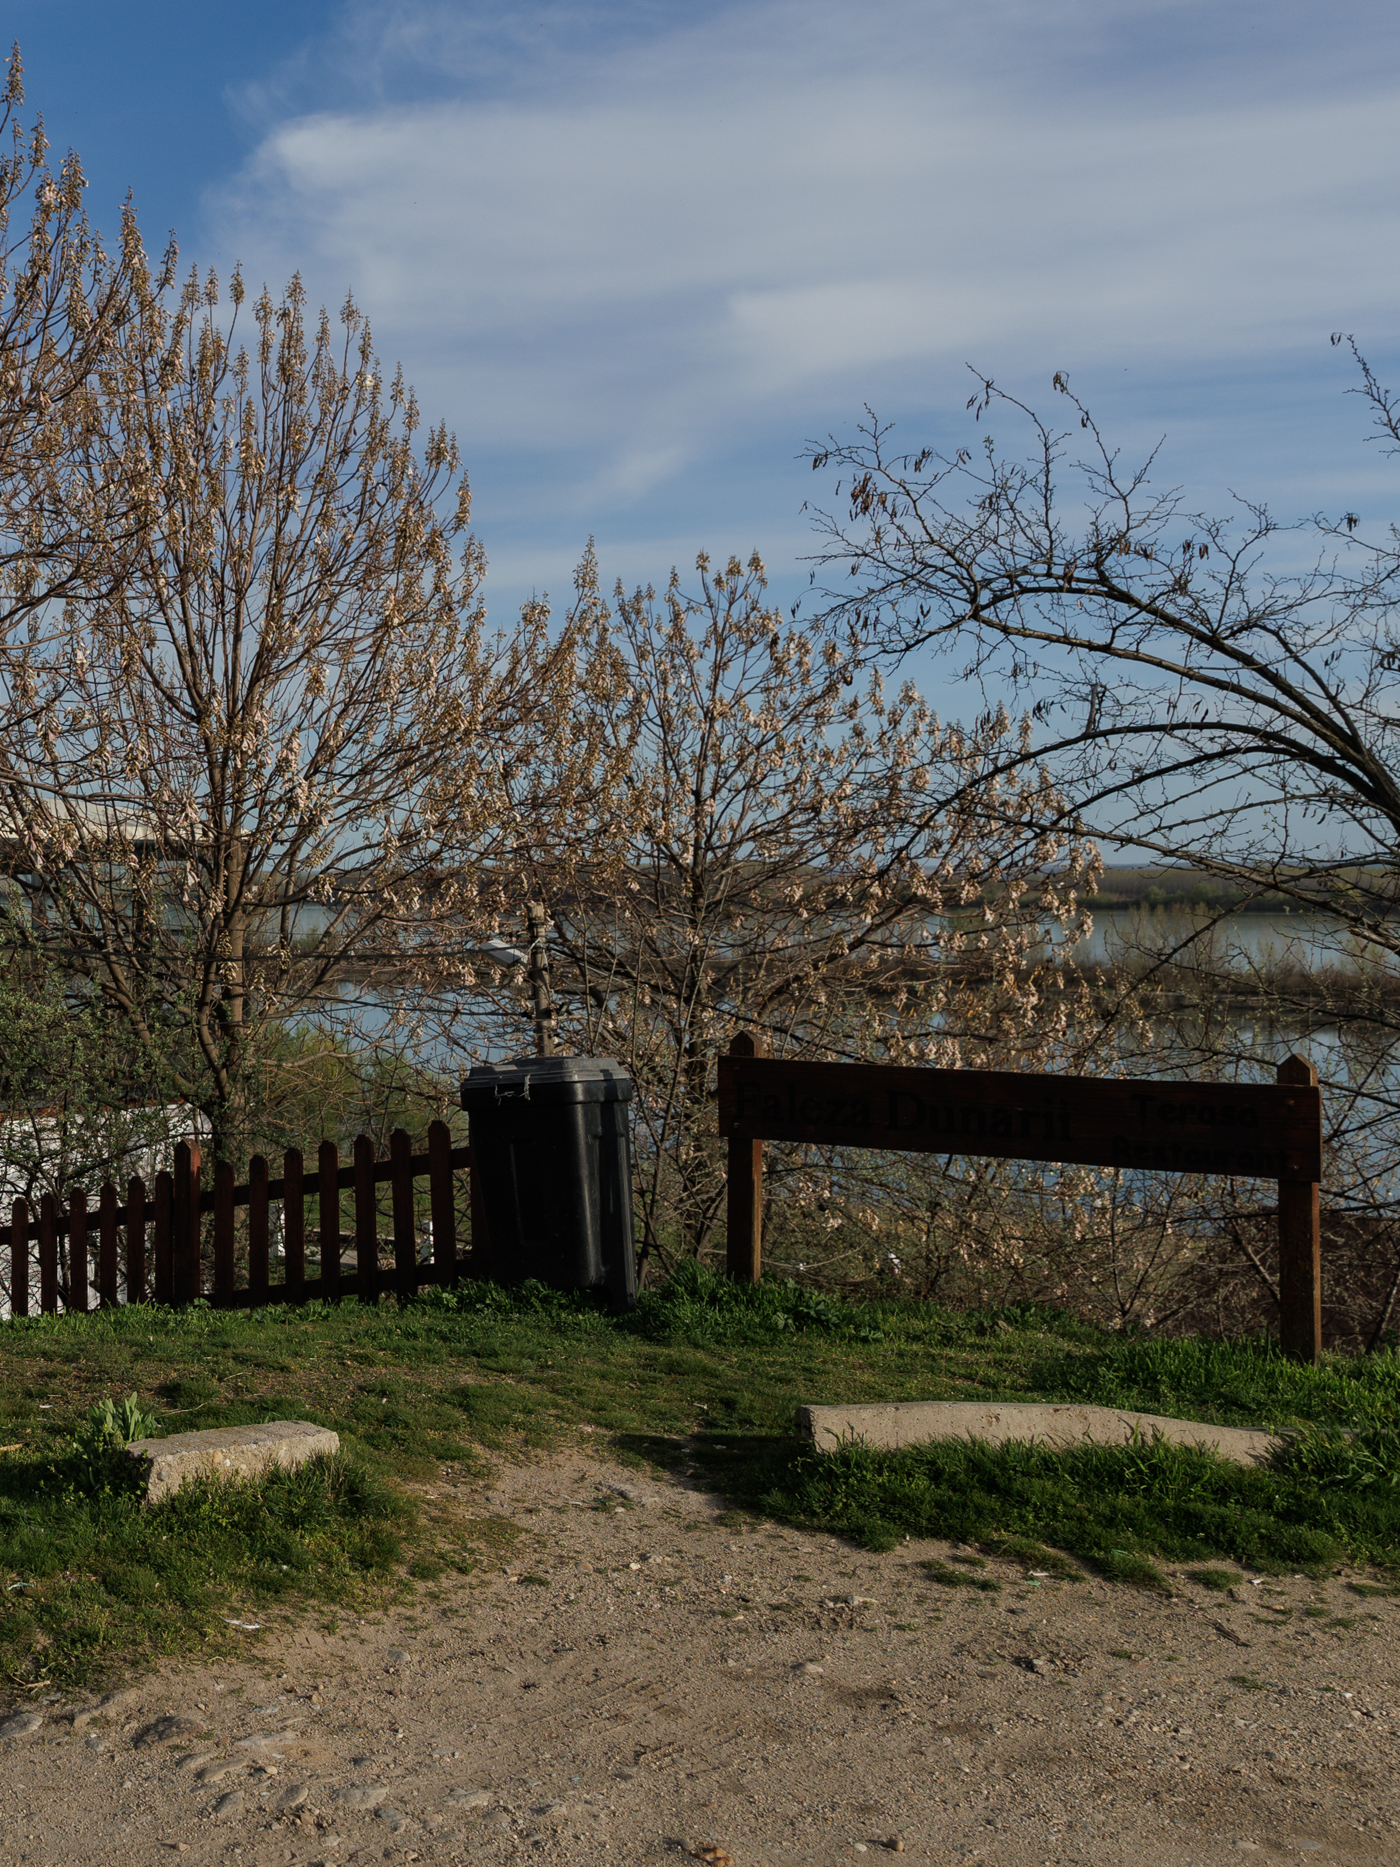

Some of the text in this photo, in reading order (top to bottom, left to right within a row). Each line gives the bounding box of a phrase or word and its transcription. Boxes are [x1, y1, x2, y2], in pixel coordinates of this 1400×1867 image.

[732, 1080, 1074, 1143] Faleza Dunarii
[1129, 1092, 1261, 1129] Terasa
[1110, 1134, 1292, 1174] Restaurant
